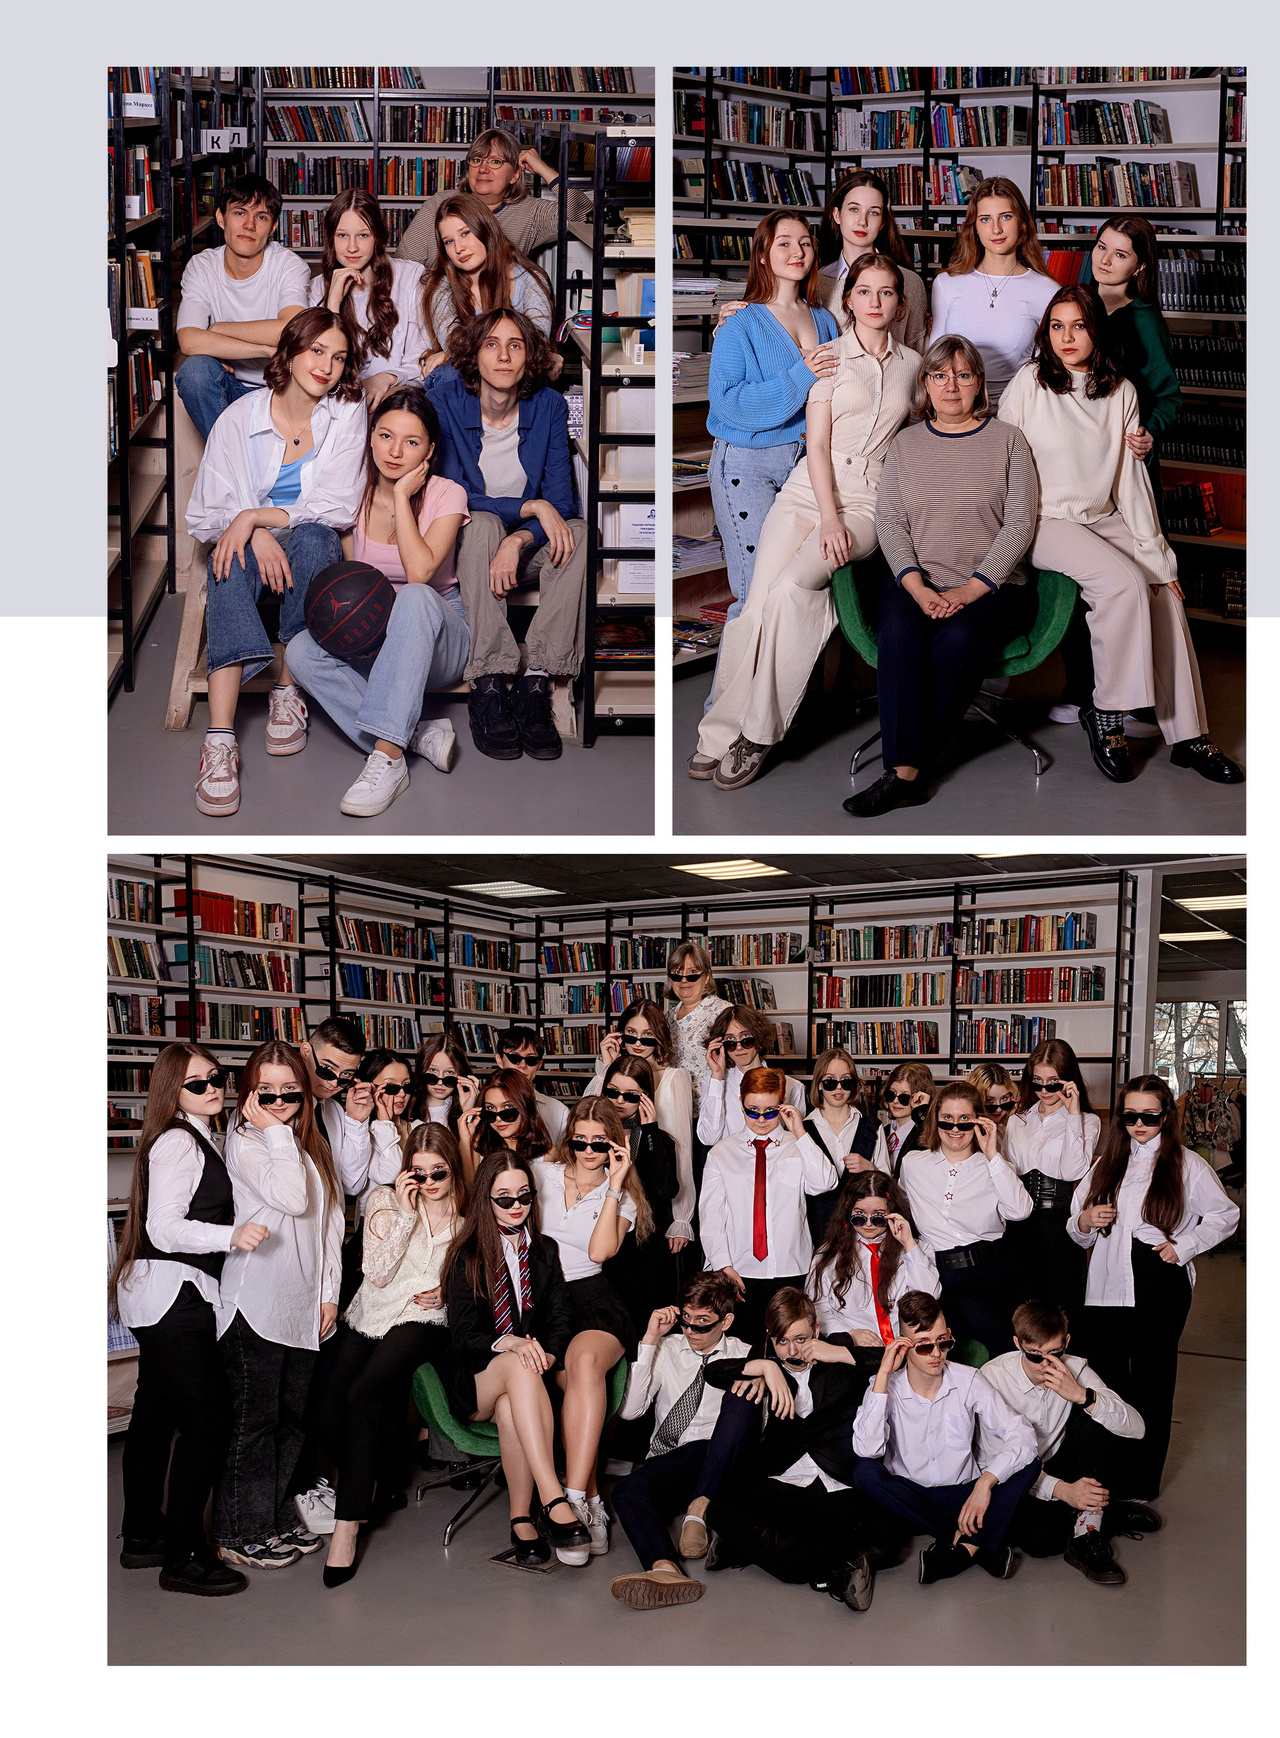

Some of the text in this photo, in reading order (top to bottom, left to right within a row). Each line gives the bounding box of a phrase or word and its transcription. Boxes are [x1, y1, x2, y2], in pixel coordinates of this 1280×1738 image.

[211, 135, 222, 149] К
[230, 132, 240, 144] Л
[927, 187, 933, 198] Р
[336, 602, 384, 648] JORDAN
[274, 926, 280, 937] Е
